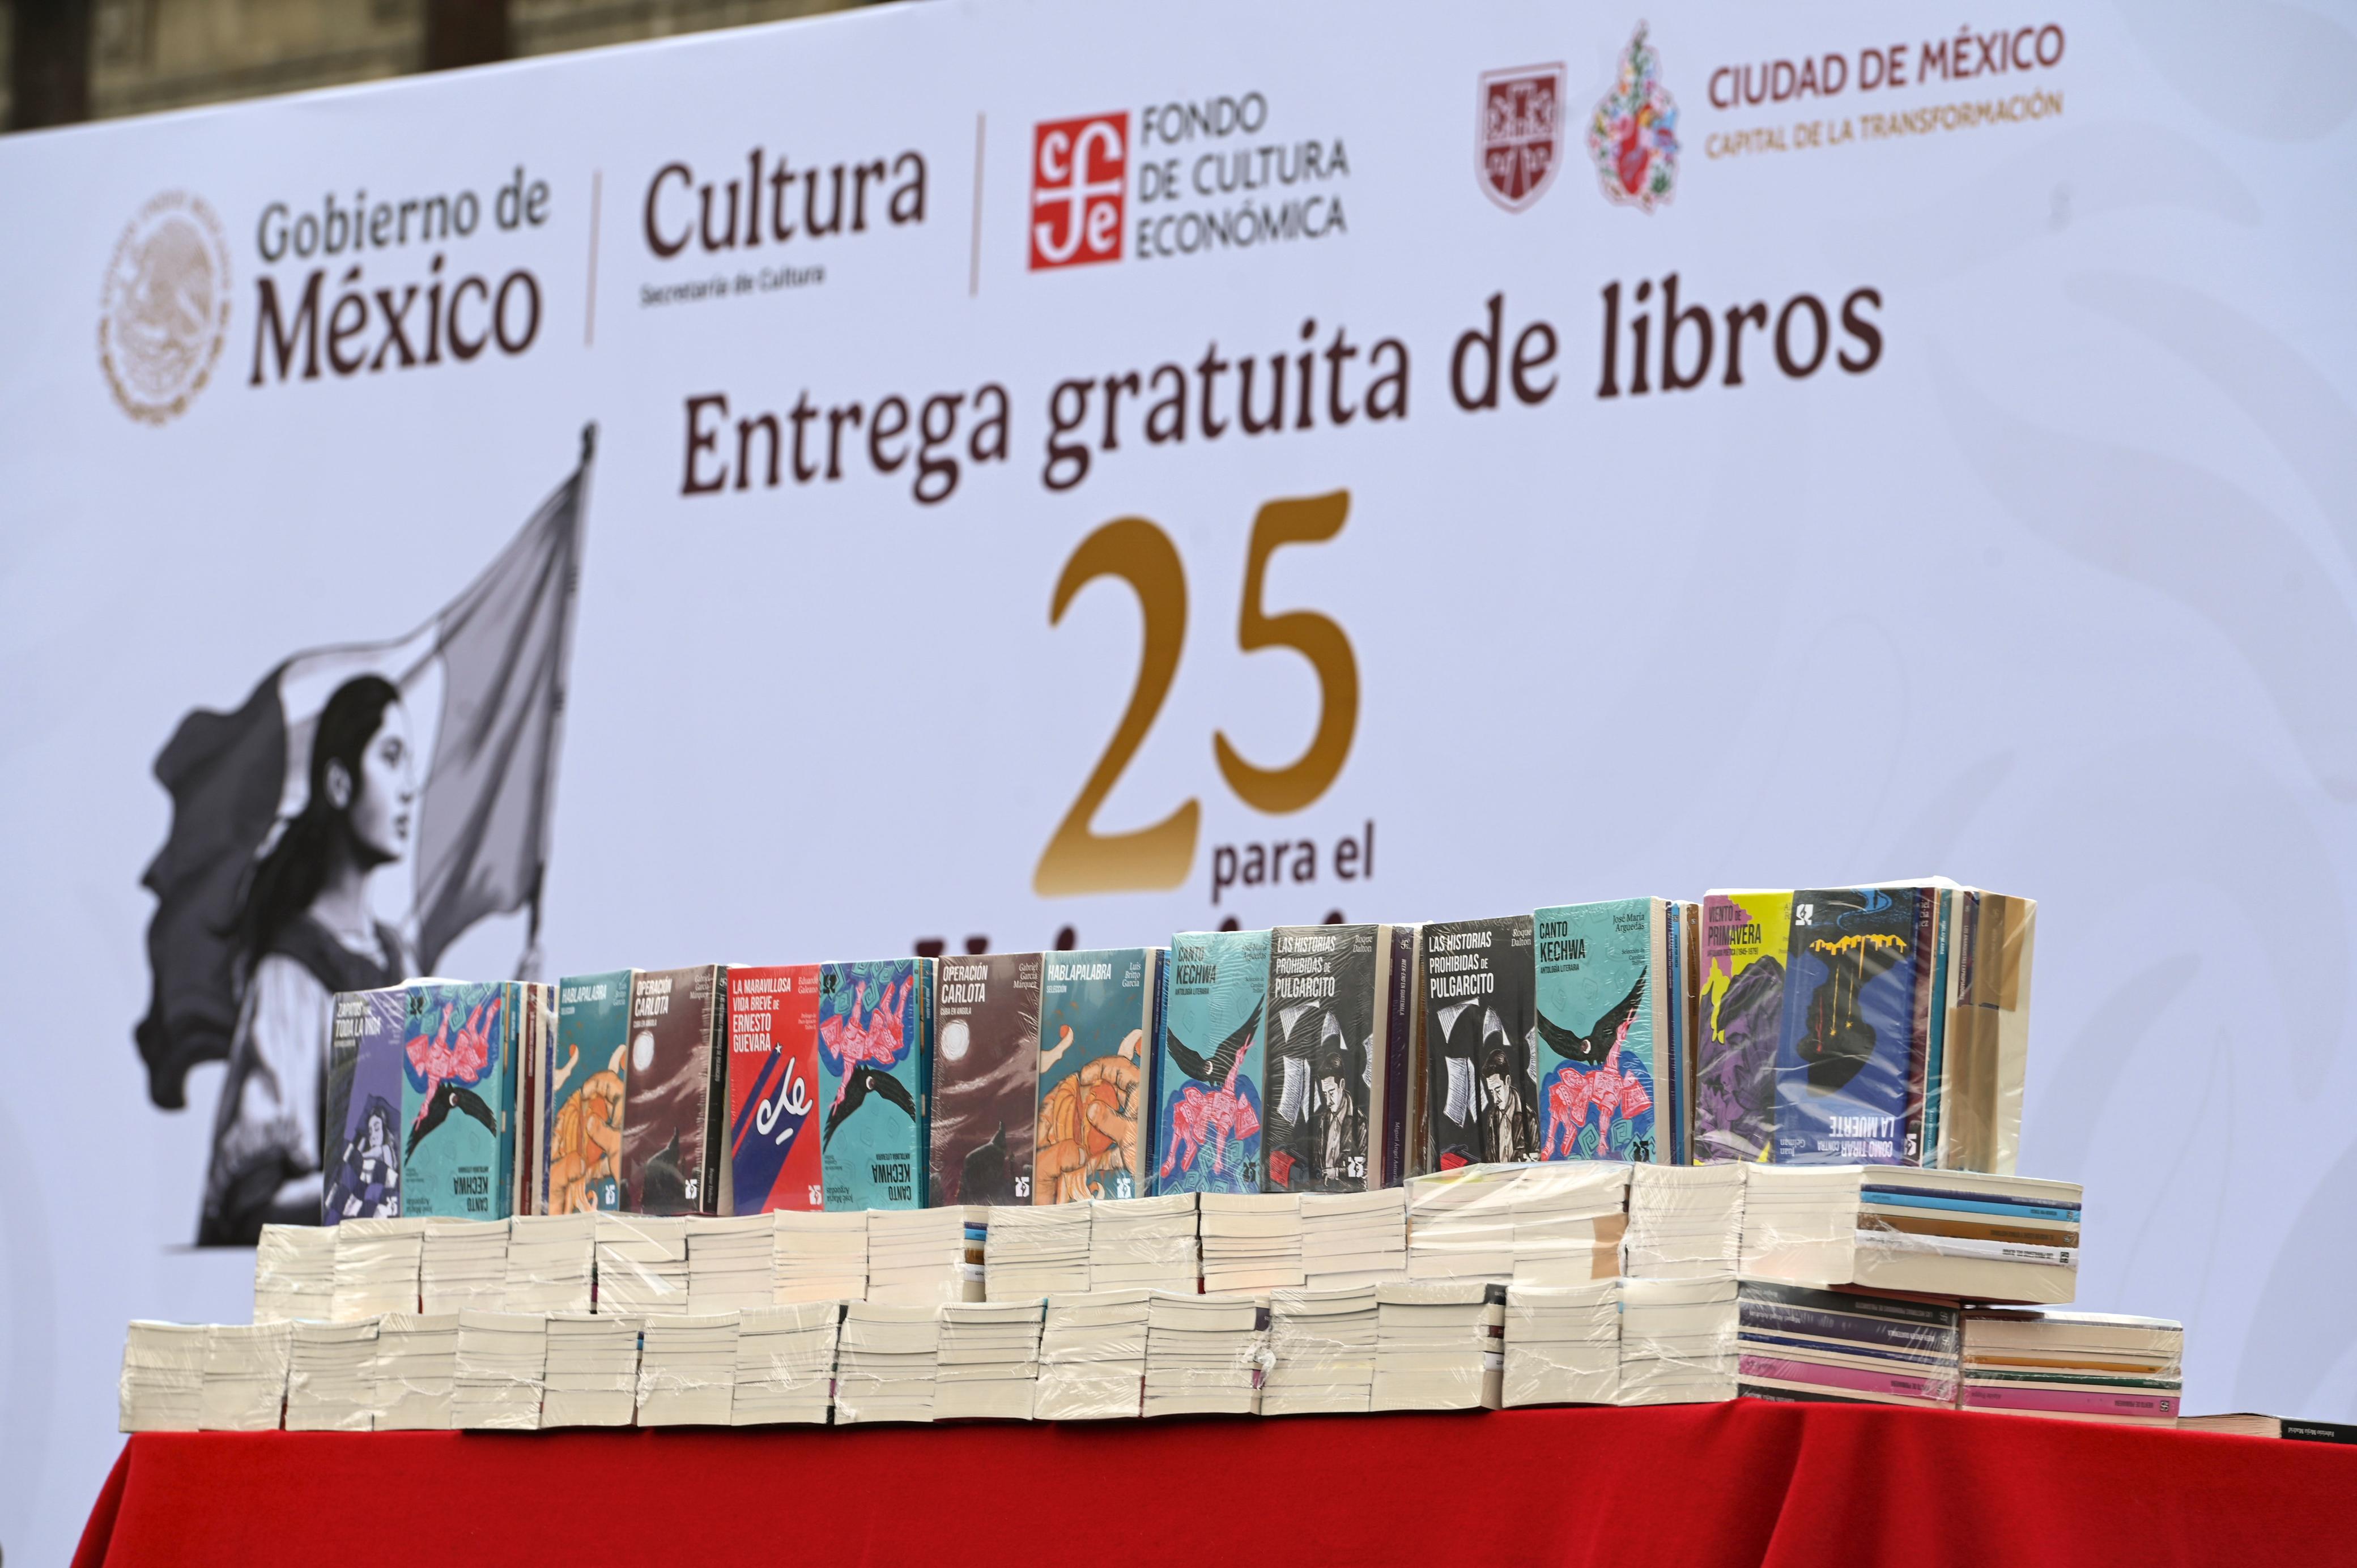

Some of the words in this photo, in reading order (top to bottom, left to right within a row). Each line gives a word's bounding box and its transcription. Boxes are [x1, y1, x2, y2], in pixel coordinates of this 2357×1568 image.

[1708, 54, 1848, 110] CIUDAD
[1858, 45, 1908, 91] DE
[1917, 23, 2066, 83] MÉXICO
[1141, 91, 1268, 147] FONDO
[1705, 123, 1789, 160] CAPITAL
[1792, 120, 1824, 150] DE
[1827, 115, 1857, 146] LA
[1860, 88, 2065, 142] TRANSFORMACIÓN
[1139, 159, 1181, 204] DE
[1192, 138, 1350, 196] CULTURA
[643, 146, 928, 260] Cultura
[257, 189, 480, 265] Gobierno
[495, 164, 551, 232] de
[1135, 195, 1348, 259] ECONÓMICA
[734, 272, 754, 295] de
[759, 265, 826, 293] Cultura
[248, 252, 543, 389] México
[680, 381, 1012, 505] Entrega
[1041, 317, 1410, 492] gratuita
[1450, 291, 1559, 413] de
[1596, 270, 1884, 399] libros
[1031, 487, 1361, 898] 25
[1211, 836, 1316, 906] para
[1333, 819, 1375, 881] el
[1613, 914, 1626, 925] José
[1627, 912, 1644, 922] María
[1708, 905, 1734, 923] VIENTO
[1735, 910, 1742, 921] DE
[1512, 928, 1532, 938] Roque
[1539, 921, 1568, 939] CANTO
[1615, 922, 1644, 934] Arguedas
[1707, 923, 1762, 947] PRIMAVERA
[1277, 936, 1294, 953] LAS
[1294, 935, 1336, 953] HISTORIAS
[1352, 944, 1372, 953] Dalton
[1355, 935, 1373, 945] Roque
[1429, 935, 1445, 953] LAS
[1446, 931, 1492, 951] HISTORIAS
[1511, 938, 1531, 947] Dalton
[1178, 947, 1206, 962] CANTO
[1540, 939, 1585, 962] KECHWA
[943, 962, 988, 982] OPERACIÓN
[1019, 962, 1039, 972] Gabriel
[1048, 963, 1112, 981] HABLAPALABRA
[1129, 961, 1141, 970] Luis
[1276, 957, 1323, 974] PROHIBIDAS
[1324, 962, 1331, 973] DE
[1429, 953, 1479, 974] PROHIBIDAS
[1480, 958, 1488, 969] DE
[1560, 964, 1580, 973] LITERARIA
[1020, 972, 1037, 980] García
[1125, 970, 1140, 980] Britto
[1176, 964, 1216, 985] KECHWA
[561, 984, 607, 1004] HABLAPALABRA
[636, 975, 673, 996] OPERACIÓN
[733, 979, 743, 995] LA
[744, 977, 791, 994] MARAVILLOSA
[941, 983, 985, 1004] CARLOTA
[1275, 976, 1335, 998] PULGARCITO
[1430, 973, 1494, 999] PULGARCITO
[635, 995, 669, 1017] CARLOTA
[733, 996, 749, 1012] VIDA
[750, 995, 772, 1011] BREVE
[772, 999, 780, 1010] DE
[354, 1018, 363, 1037] LA
[733, 1012, 771, 1033] ERNESTO
[733, 1033, 771, 1053] GUEVARA
[1829, 1116, 1878, 1137] MUERTE
[1881, 1117, 1895, 1138] LA
[1780, 1138, 1806, 1148] Gelman
[1780, 1148, 1796, 1157] Juan
[1817, 1140, 1840, 1152] CONTRA
[1841, 1141, 1867, 1157] TIRAR
[871, 1164, 911, 1183] KECHWA
[454, 1177, 488, 1195] KECHWA
[888, 1186, 912, 1201] CANTO
[467, 1198, 488, 1212] CANTO
